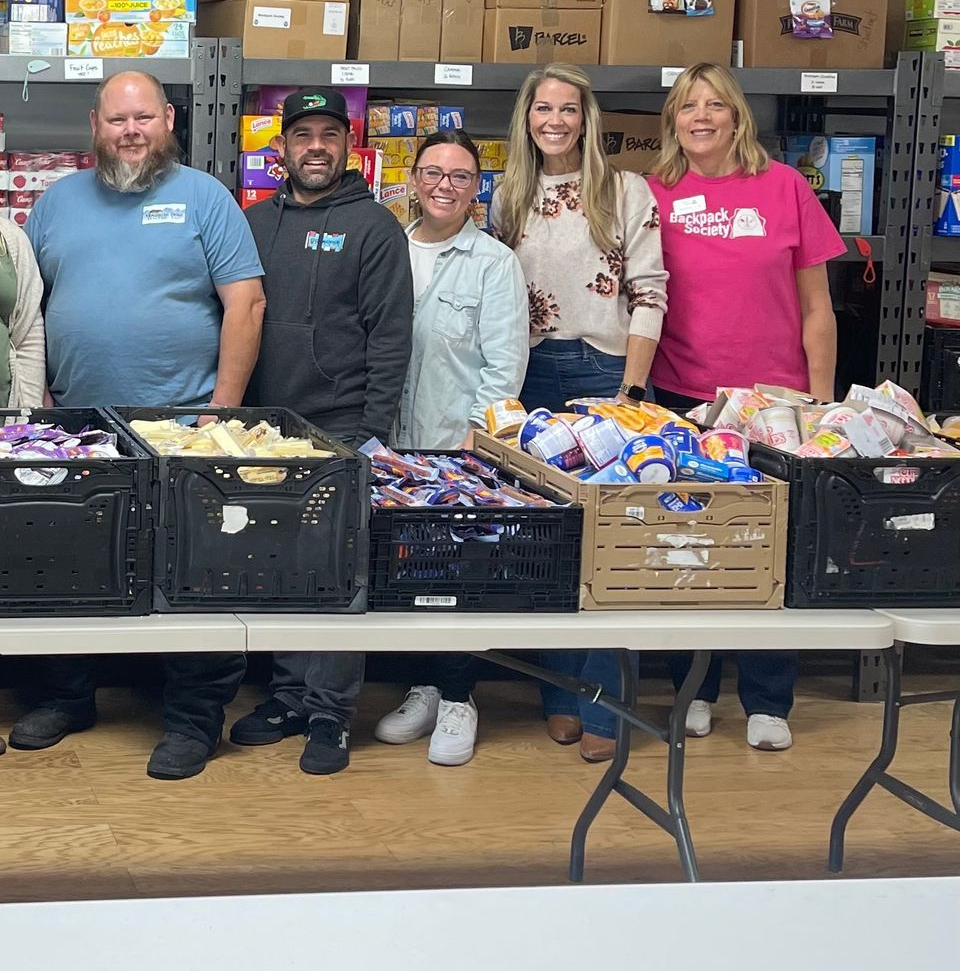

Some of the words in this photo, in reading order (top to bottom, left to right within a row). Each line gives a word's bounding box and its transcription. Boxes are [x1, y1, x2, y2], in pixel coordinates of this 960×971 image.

[246, 189, 257, 198] 12
[669, 207, 730, 228] Backpack
[684, 223, 730, 239] Society
